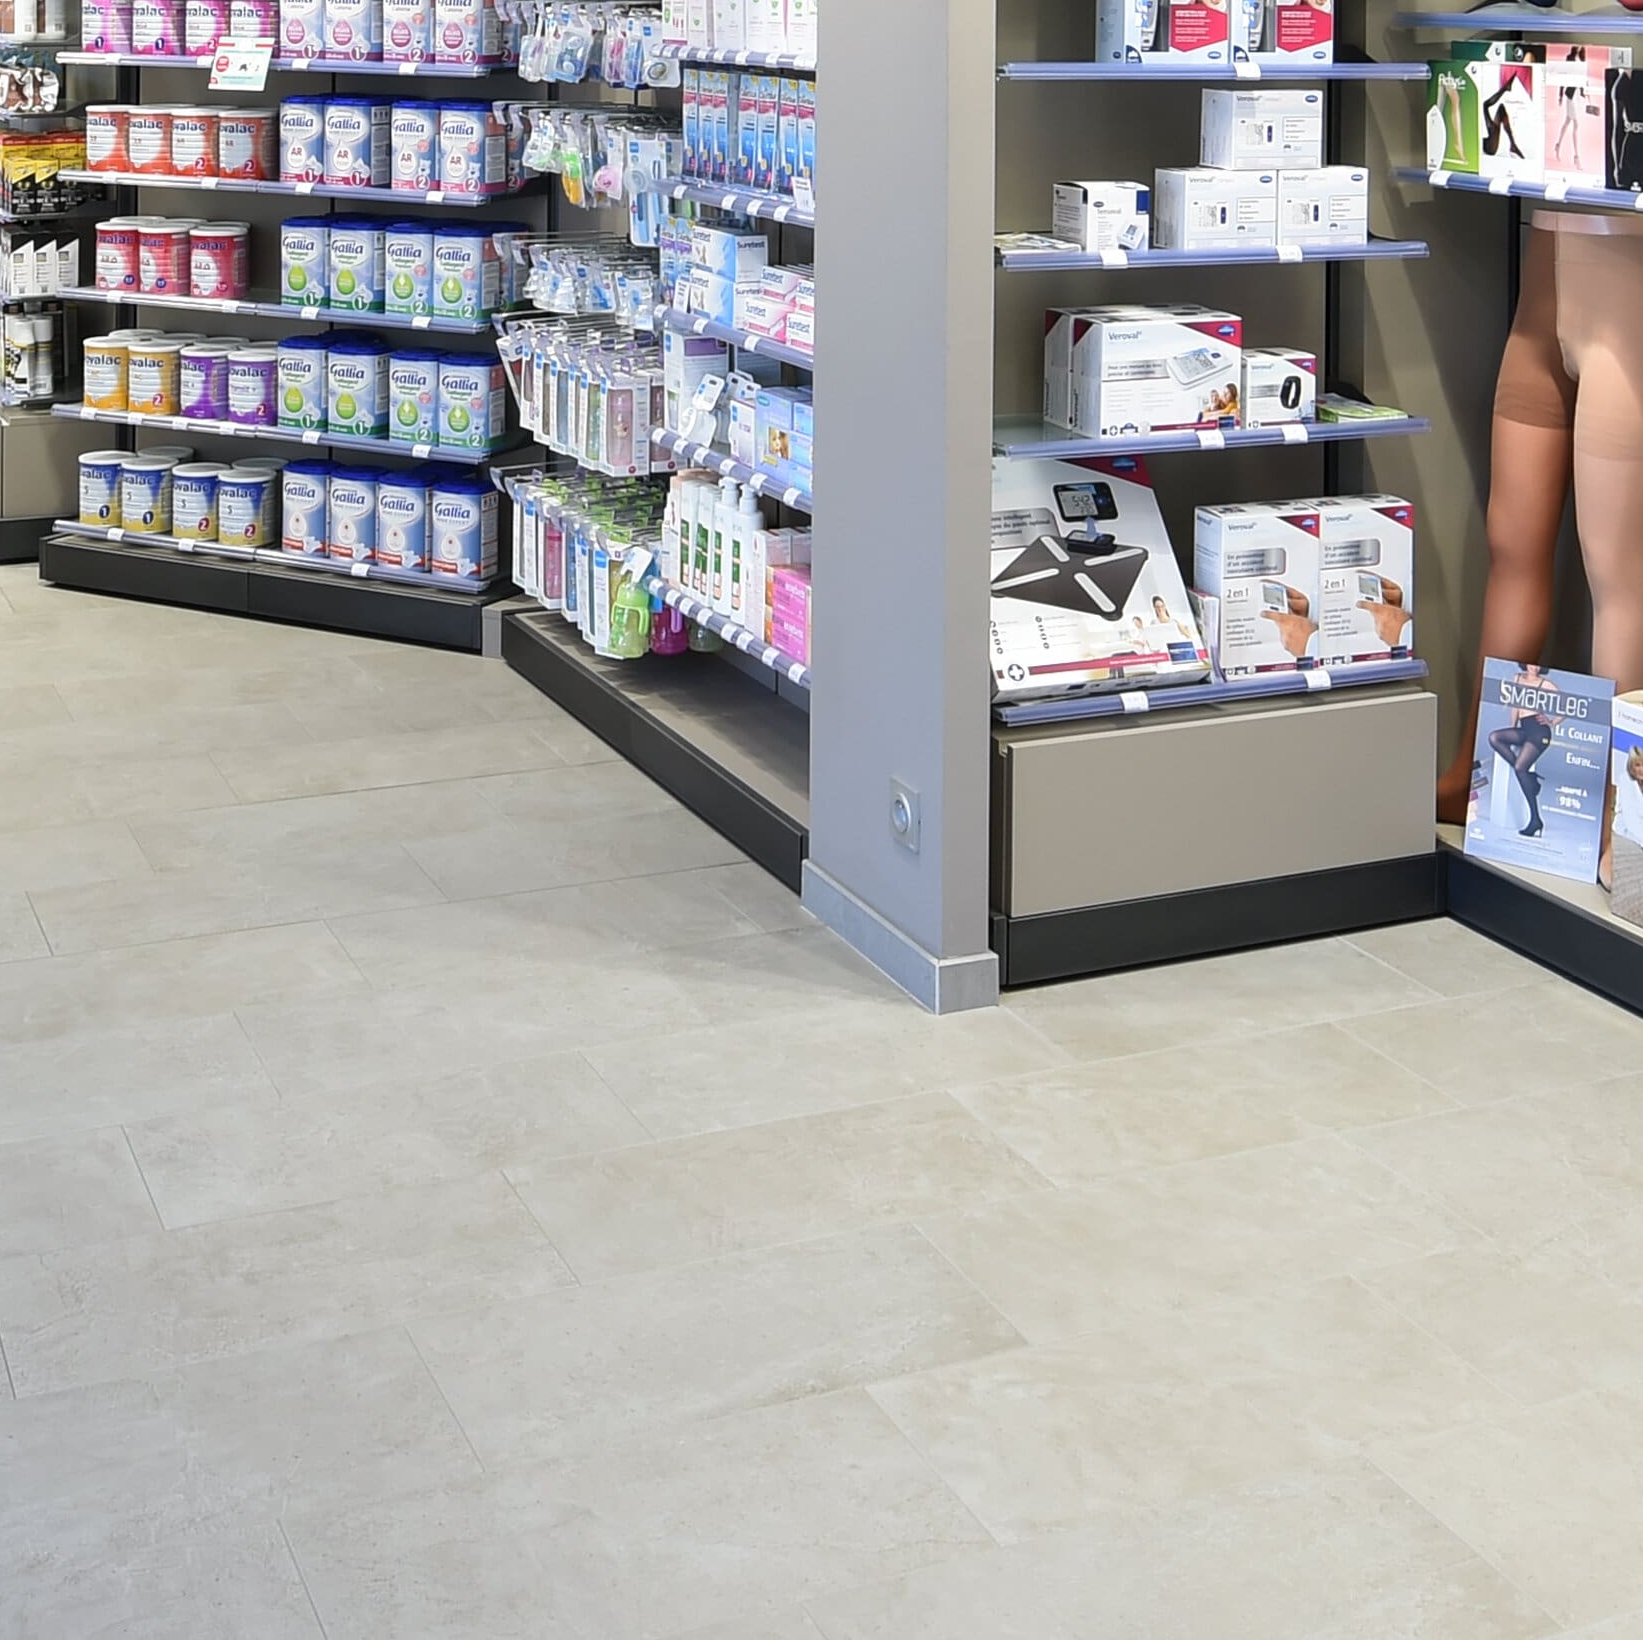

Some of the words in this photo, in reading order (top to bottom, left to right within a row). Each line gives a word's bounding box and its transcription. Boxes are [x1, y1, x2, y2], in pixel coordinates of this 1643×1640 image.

[282, 114, 313, 127] Gallia
[327, 114, 361, 130] Gallia
[442, 121, 474, 136] Gallia
[291, 148, 302, 156] AR
[337, 151, 348, 159] AR
[401, 153, 412, 162] AR
[450, 156, 462, 165] AR
[283, 236, 315, 251] Gallia
[332, 240, 363, 254] Gallia
[388, 243, 422, 258] Gallia
[436, 247, 471, 262] Gallia
[1108, 331, 1139, 341] Veroval
[1331, 580, 1341, 588] en
[1233, 589, 1243, 597] en
[1559, 797, 1580, 809] 98%
